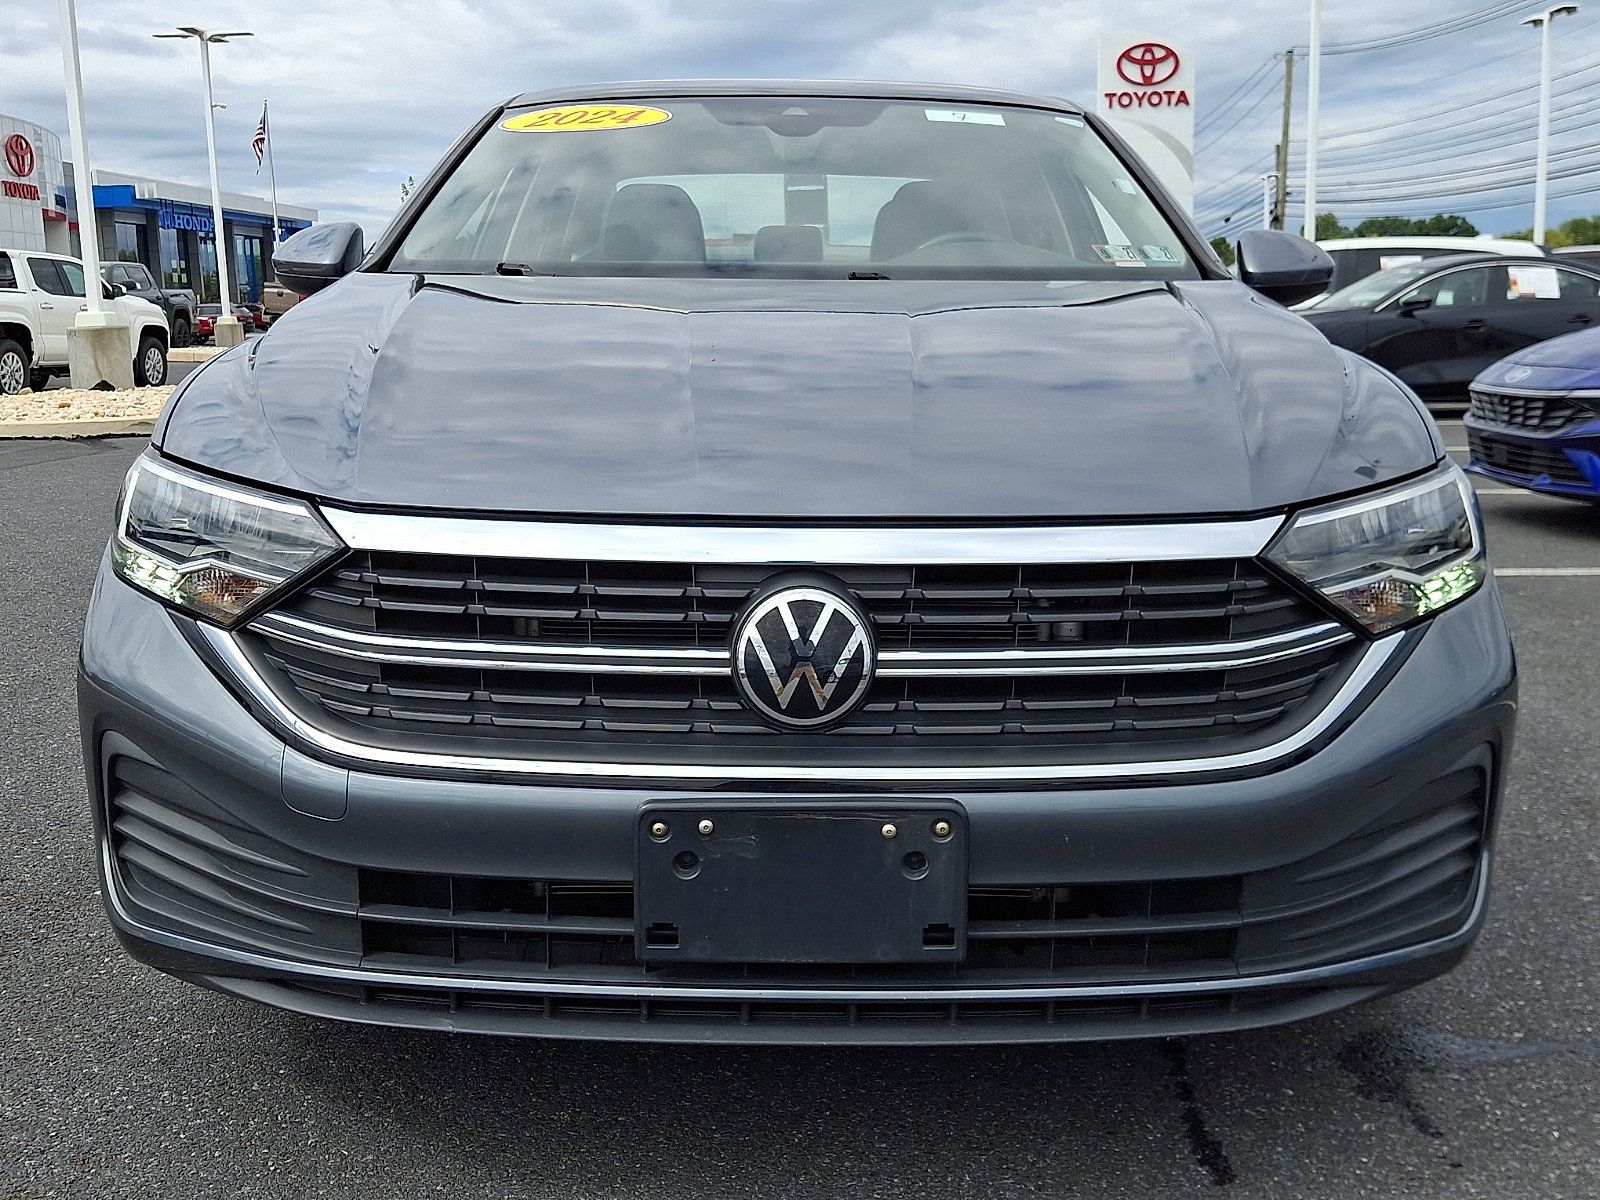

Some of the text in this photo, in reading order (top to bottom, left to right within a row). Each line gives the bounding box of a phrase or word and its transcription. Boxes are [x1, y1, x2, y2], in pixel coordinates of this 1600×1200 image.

[1104, 90, 1190, 109] TOYOTA
[523, 109, 647, 128] 2024
[2, 180, 40, 201] TOYOTA
